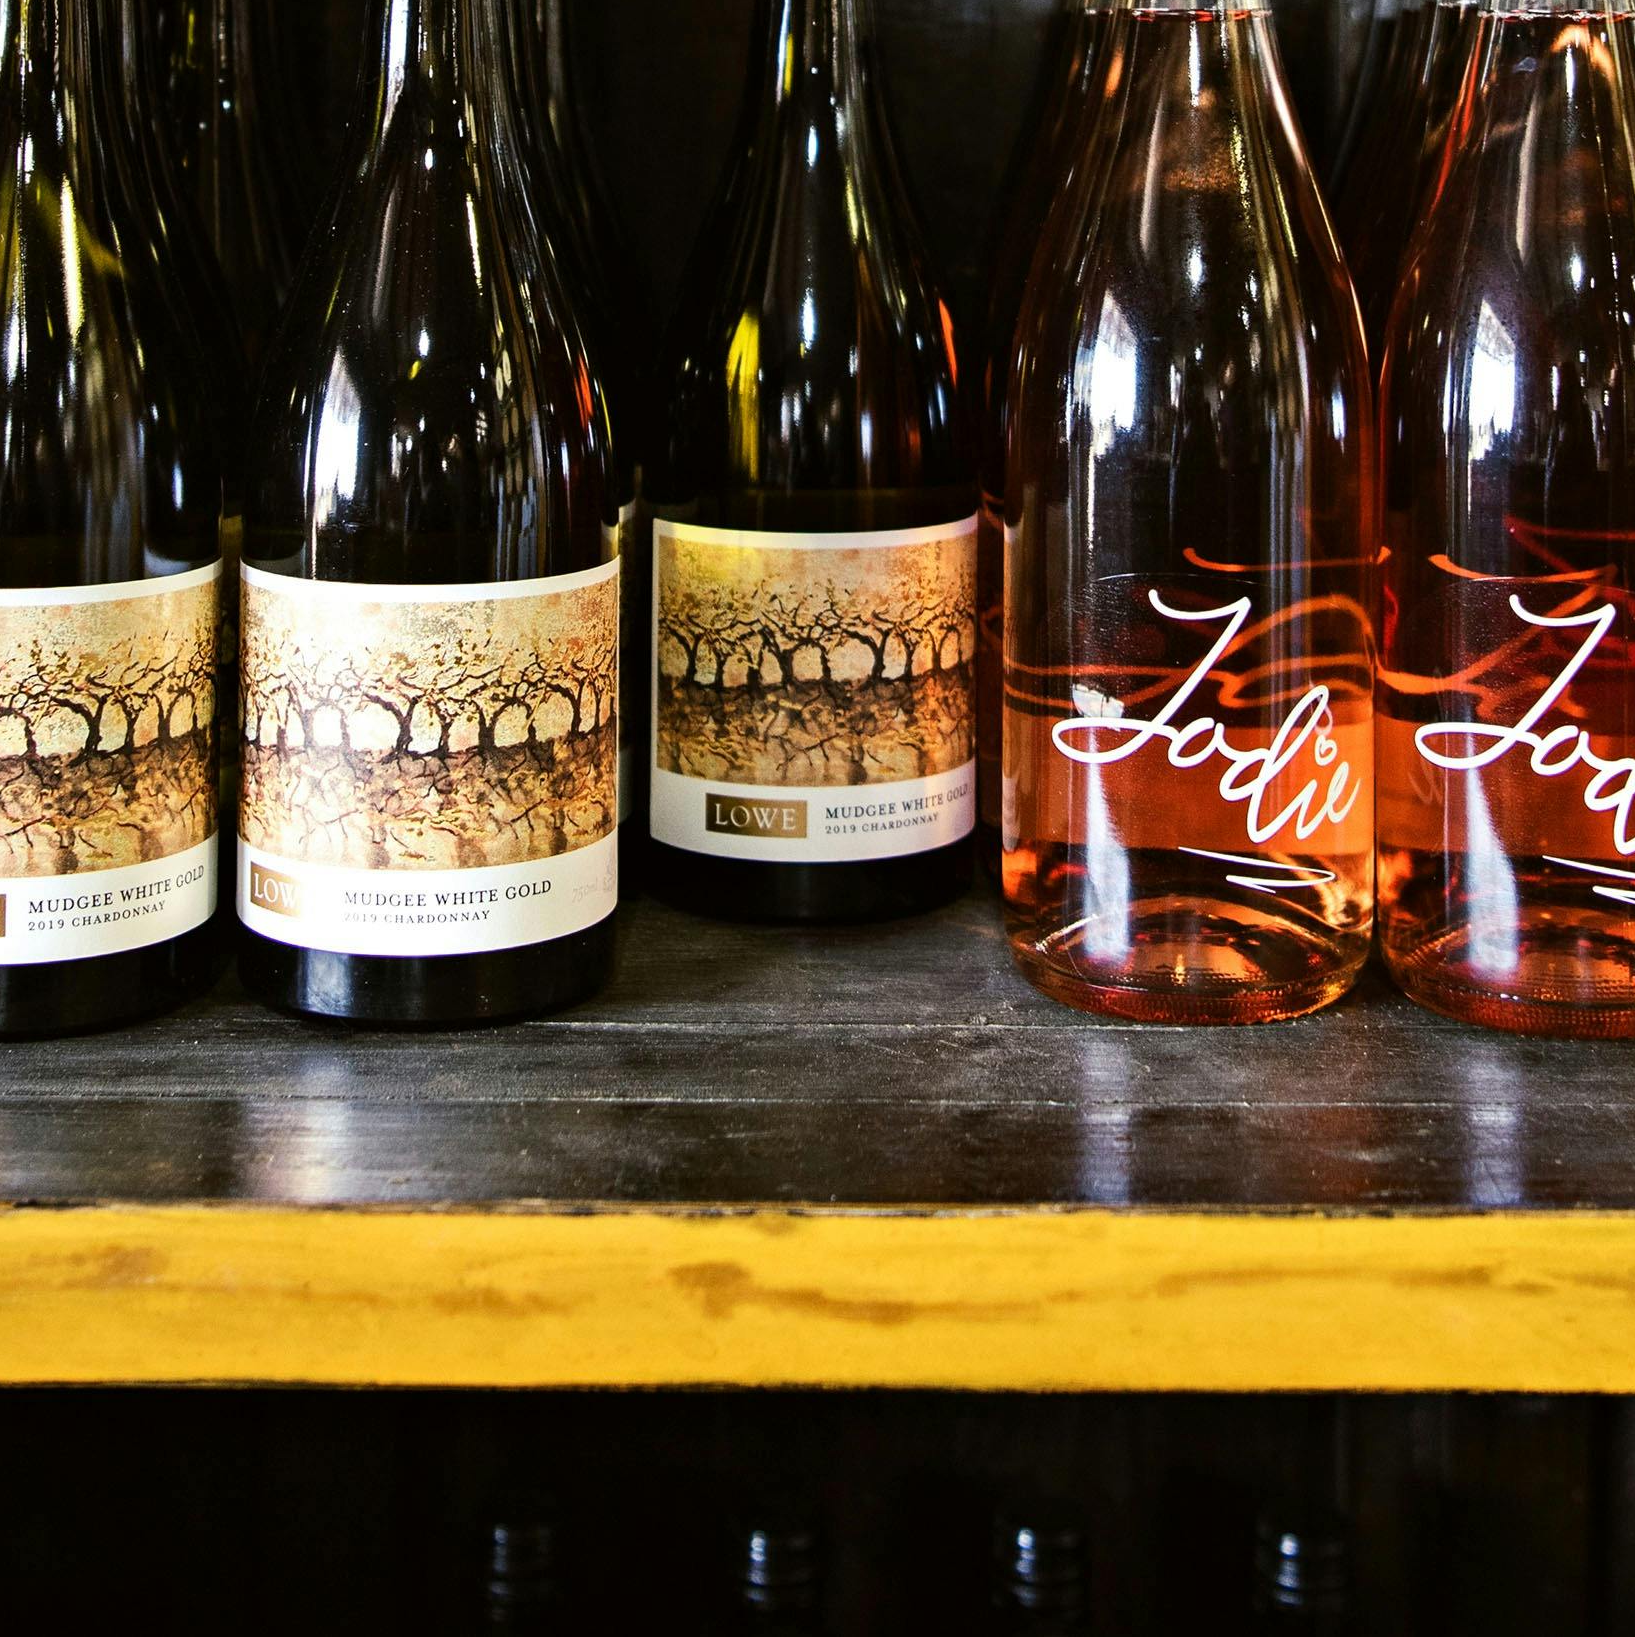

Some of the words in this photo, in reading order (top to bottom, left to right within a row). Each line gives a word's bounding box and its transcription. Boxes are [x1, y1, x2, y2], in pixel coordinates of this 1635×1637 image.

[825, 802, 896, 819] MUDGEE
[902, 792, 944, 812] WHITE
[947, 784, 968, 804] GOLD
[715, 803, 796, 831] LOWE
[825, 824, 856, 834] 2019
[861, 813, 939, 833] CHARDONNAY
[28, 892, 113, 914] MUDGEE
[120, 878, 171, 903] WHITE
[176, 864, 205, 889] GOLD
[345, 890, 427, 908] MUDGEE
[434, 889, 498, 907] WHITE
[505, 879, 552, 901] GOLD
[28, 919, 65, 932] 2019
[71, 900, 167, 929] CHARDONNAY
[384, 910, 490, 924] CHARDONNAY
